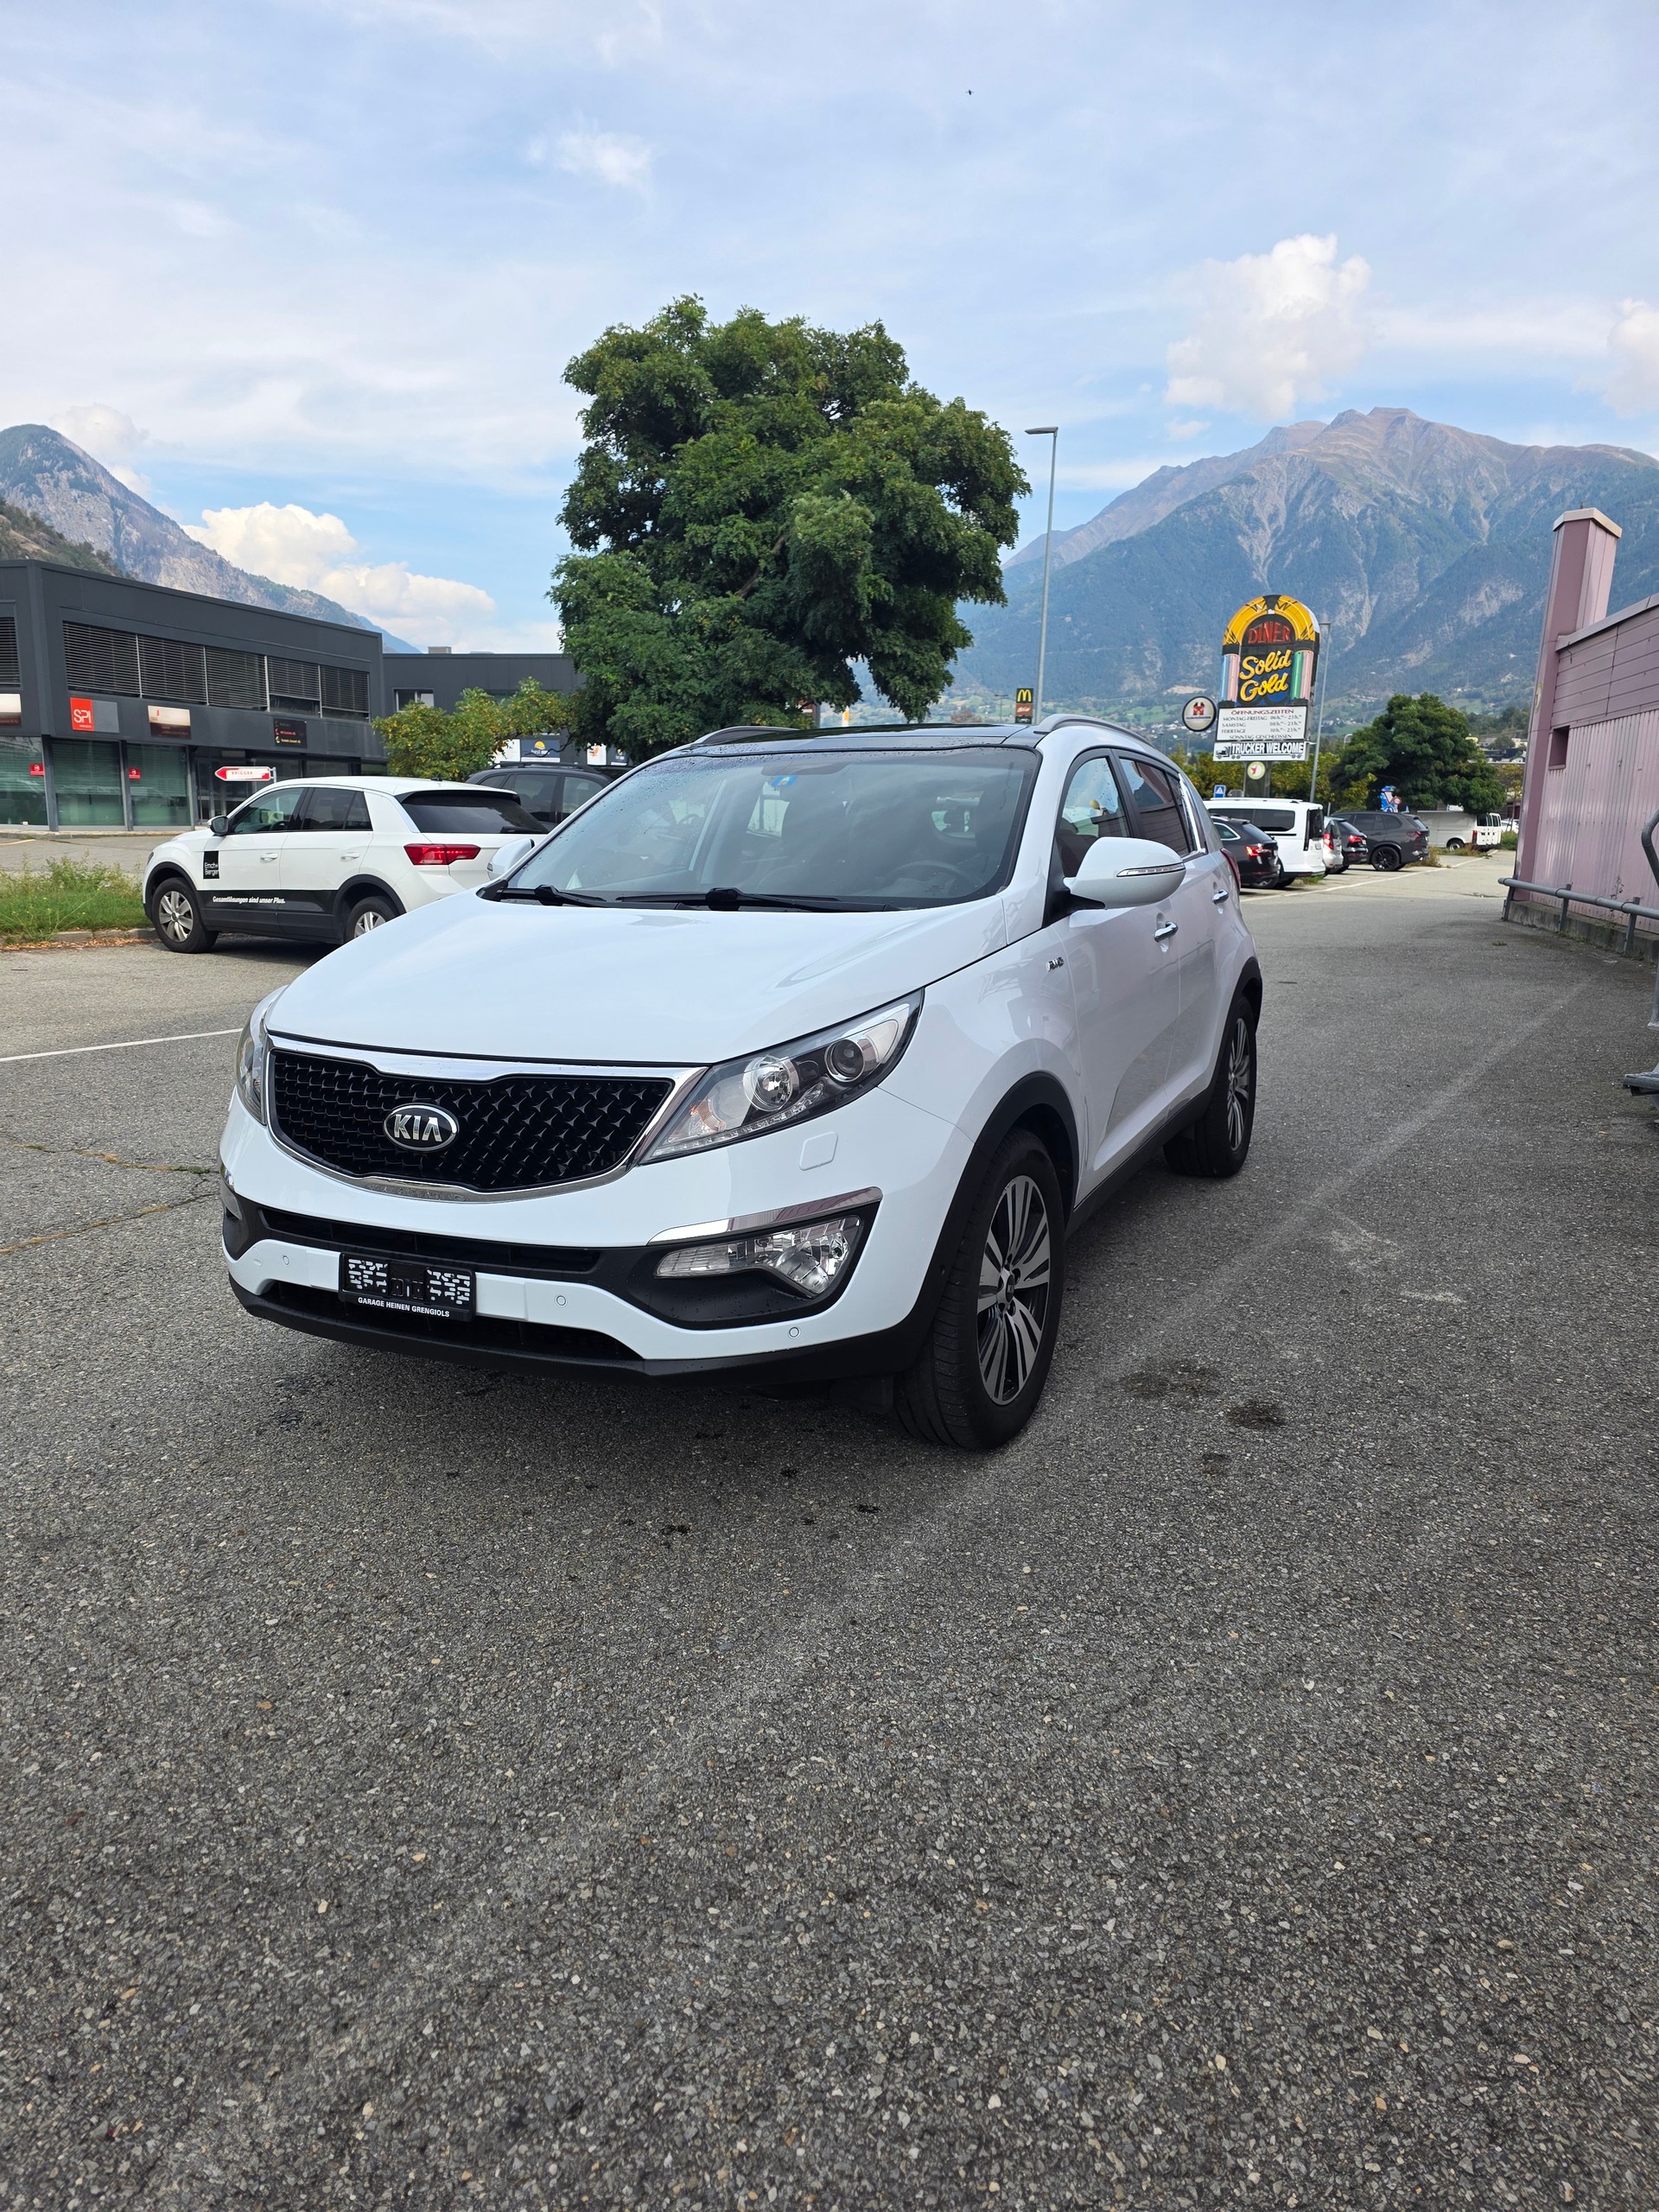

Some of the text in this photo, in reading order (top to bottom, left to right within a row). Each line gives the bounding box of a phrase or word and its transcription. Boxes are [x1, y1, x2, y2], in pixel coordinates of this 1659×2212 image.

[1249, 620, 1291, 645] DINER
[1239, 649, 1292, 680] Solid
[1240, 672, 1288, 702] Gold
[73, 709, 92, 723] SPI
[1231, 741, 1304, 754] TRUCKER WELCOME
[393, 1114, 442, 1142] KIA
[358, 1297, 450, 1318] GARAGE HEINEN GRENGIOLS
